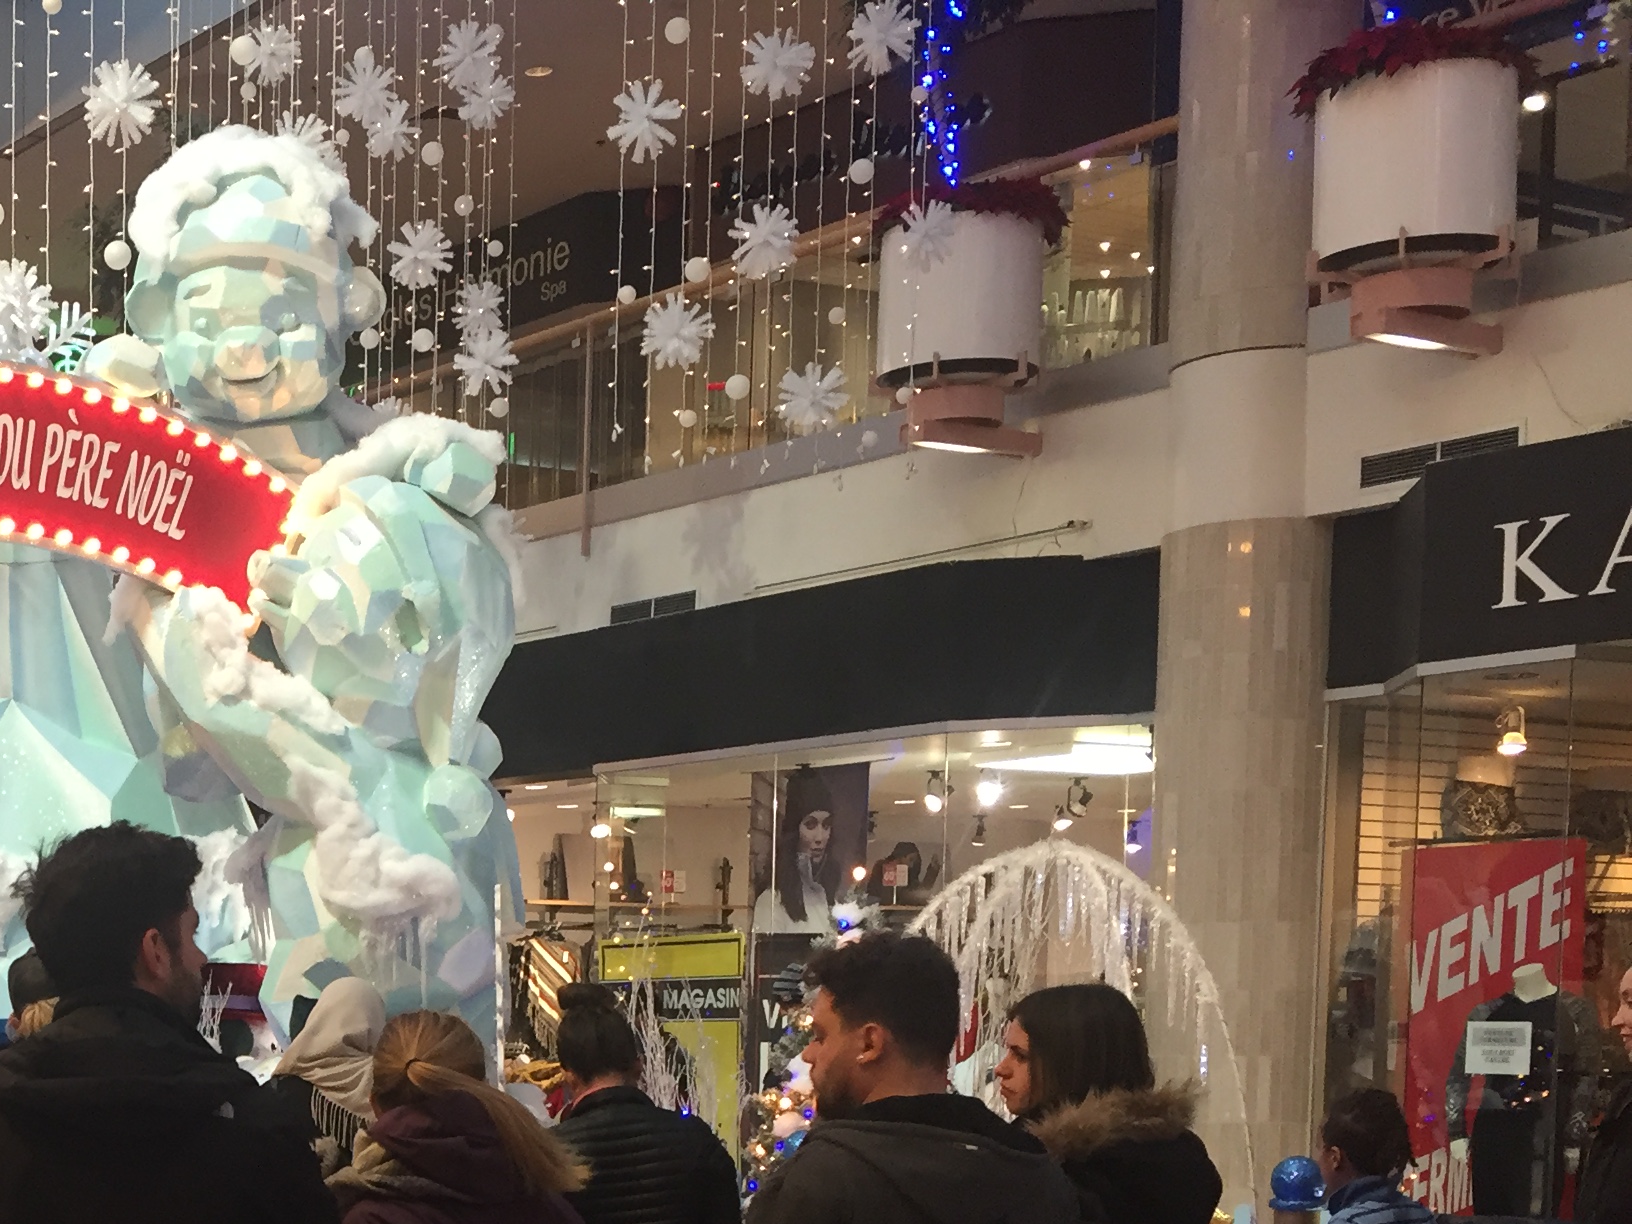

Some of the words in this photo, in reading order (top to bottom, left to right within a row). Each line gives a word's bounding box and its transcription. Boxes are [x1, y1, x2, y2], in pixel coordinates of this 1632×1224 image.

[541, 280, 567, 302] Spa
[38, 408, 121, 509] PÈRE
[115, 449, 194, 541] NOËL
[1405, 857, 1574, 1015] VENTE
[663, 987, 740, 1010] MAGASIN
